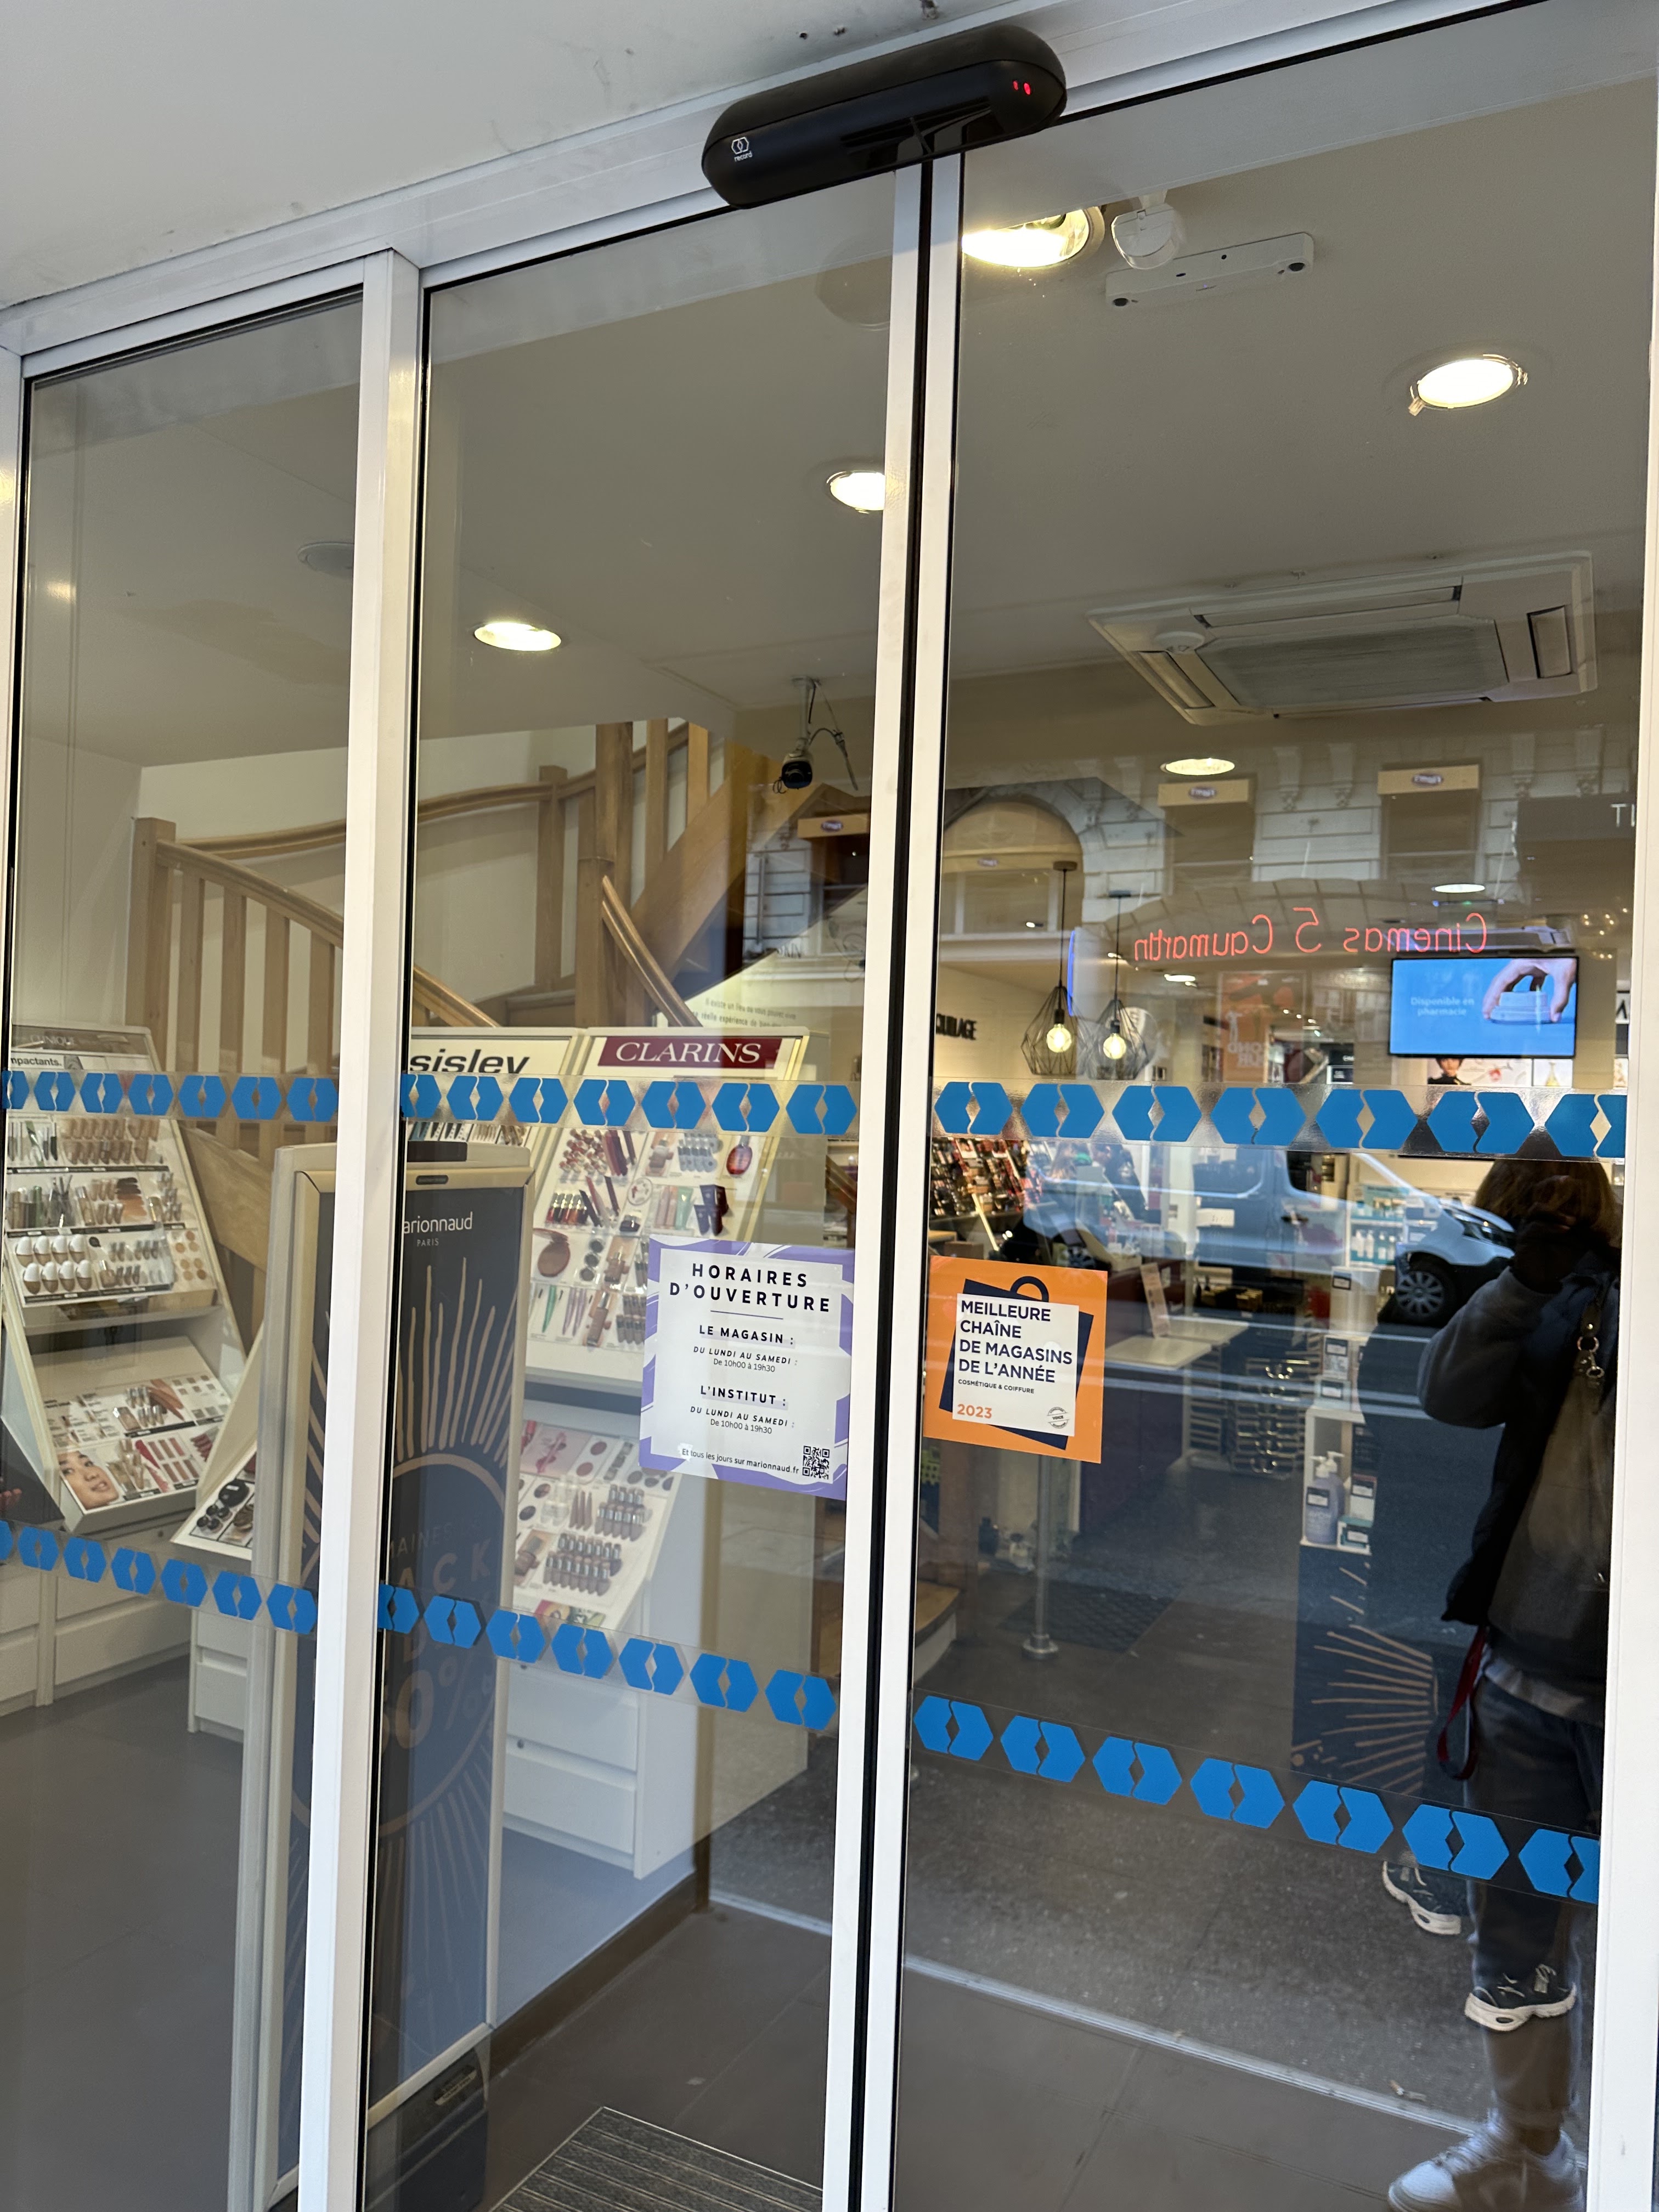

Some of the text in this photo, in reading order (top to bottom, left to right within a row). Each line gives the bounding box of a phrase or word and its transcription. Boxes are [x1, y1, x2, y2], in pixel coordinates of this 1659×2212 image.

[734, 150, 753, 162] record
[1410, 996, 1460, 1006] Disponible
[1418, 1008, 1466, 1017] pharmacie
[616, 1042, 761, 1063] CLARINS
[417, 1238, 439, 1247] PARIS
[692, 1263, 807, 1288] HORAIRES
[961, 1300, 1051, 1322] MEILLEURE
[699, 1325, 714, 1335] LE
[720, 1327, 783, 1344] MAGASIN
[960, 1319, 1022, 1339] CHAÎNE
[693, 1346, 705, 1355] DU
[709, 1348, 736, 1358] LUNDI
[740, 1351, 752, 1360] AU
[755, 1353, 791, 1364] SAMEDI
[960, 1339, 1072, 1365] DE MAGASINS
[713, 1358, 775, 1373] De 10h00 à 19h30
[959, 1359, 980, 1373] DE
[958, 1379, 997, 1389] COSMÉTIQUE
[1003, 1385, 1035, 1394] COIFFURE
[690, 1406, 702, 1414] DU
[706, 1408, 733, 1419] LUNDI
[736, 1412, 749, 1421] AU
[752, 1414, 788, 1427] SAMEDI
[957, 1403, 992, 1419] 2023
[710, 1419, 720, 1427] De
[721, 1420, 743, 1430] 10h00
[751, 1424, 772, 1434] 19h30
[682, 1448, 689, 1457] Et
[690, 1450, 704, 1459] tous
[706, 1452, 715, 1460] les
[716, 1454, 733, 1464] jours
[746, 1458, 799, 1475] marionnaud.fr
